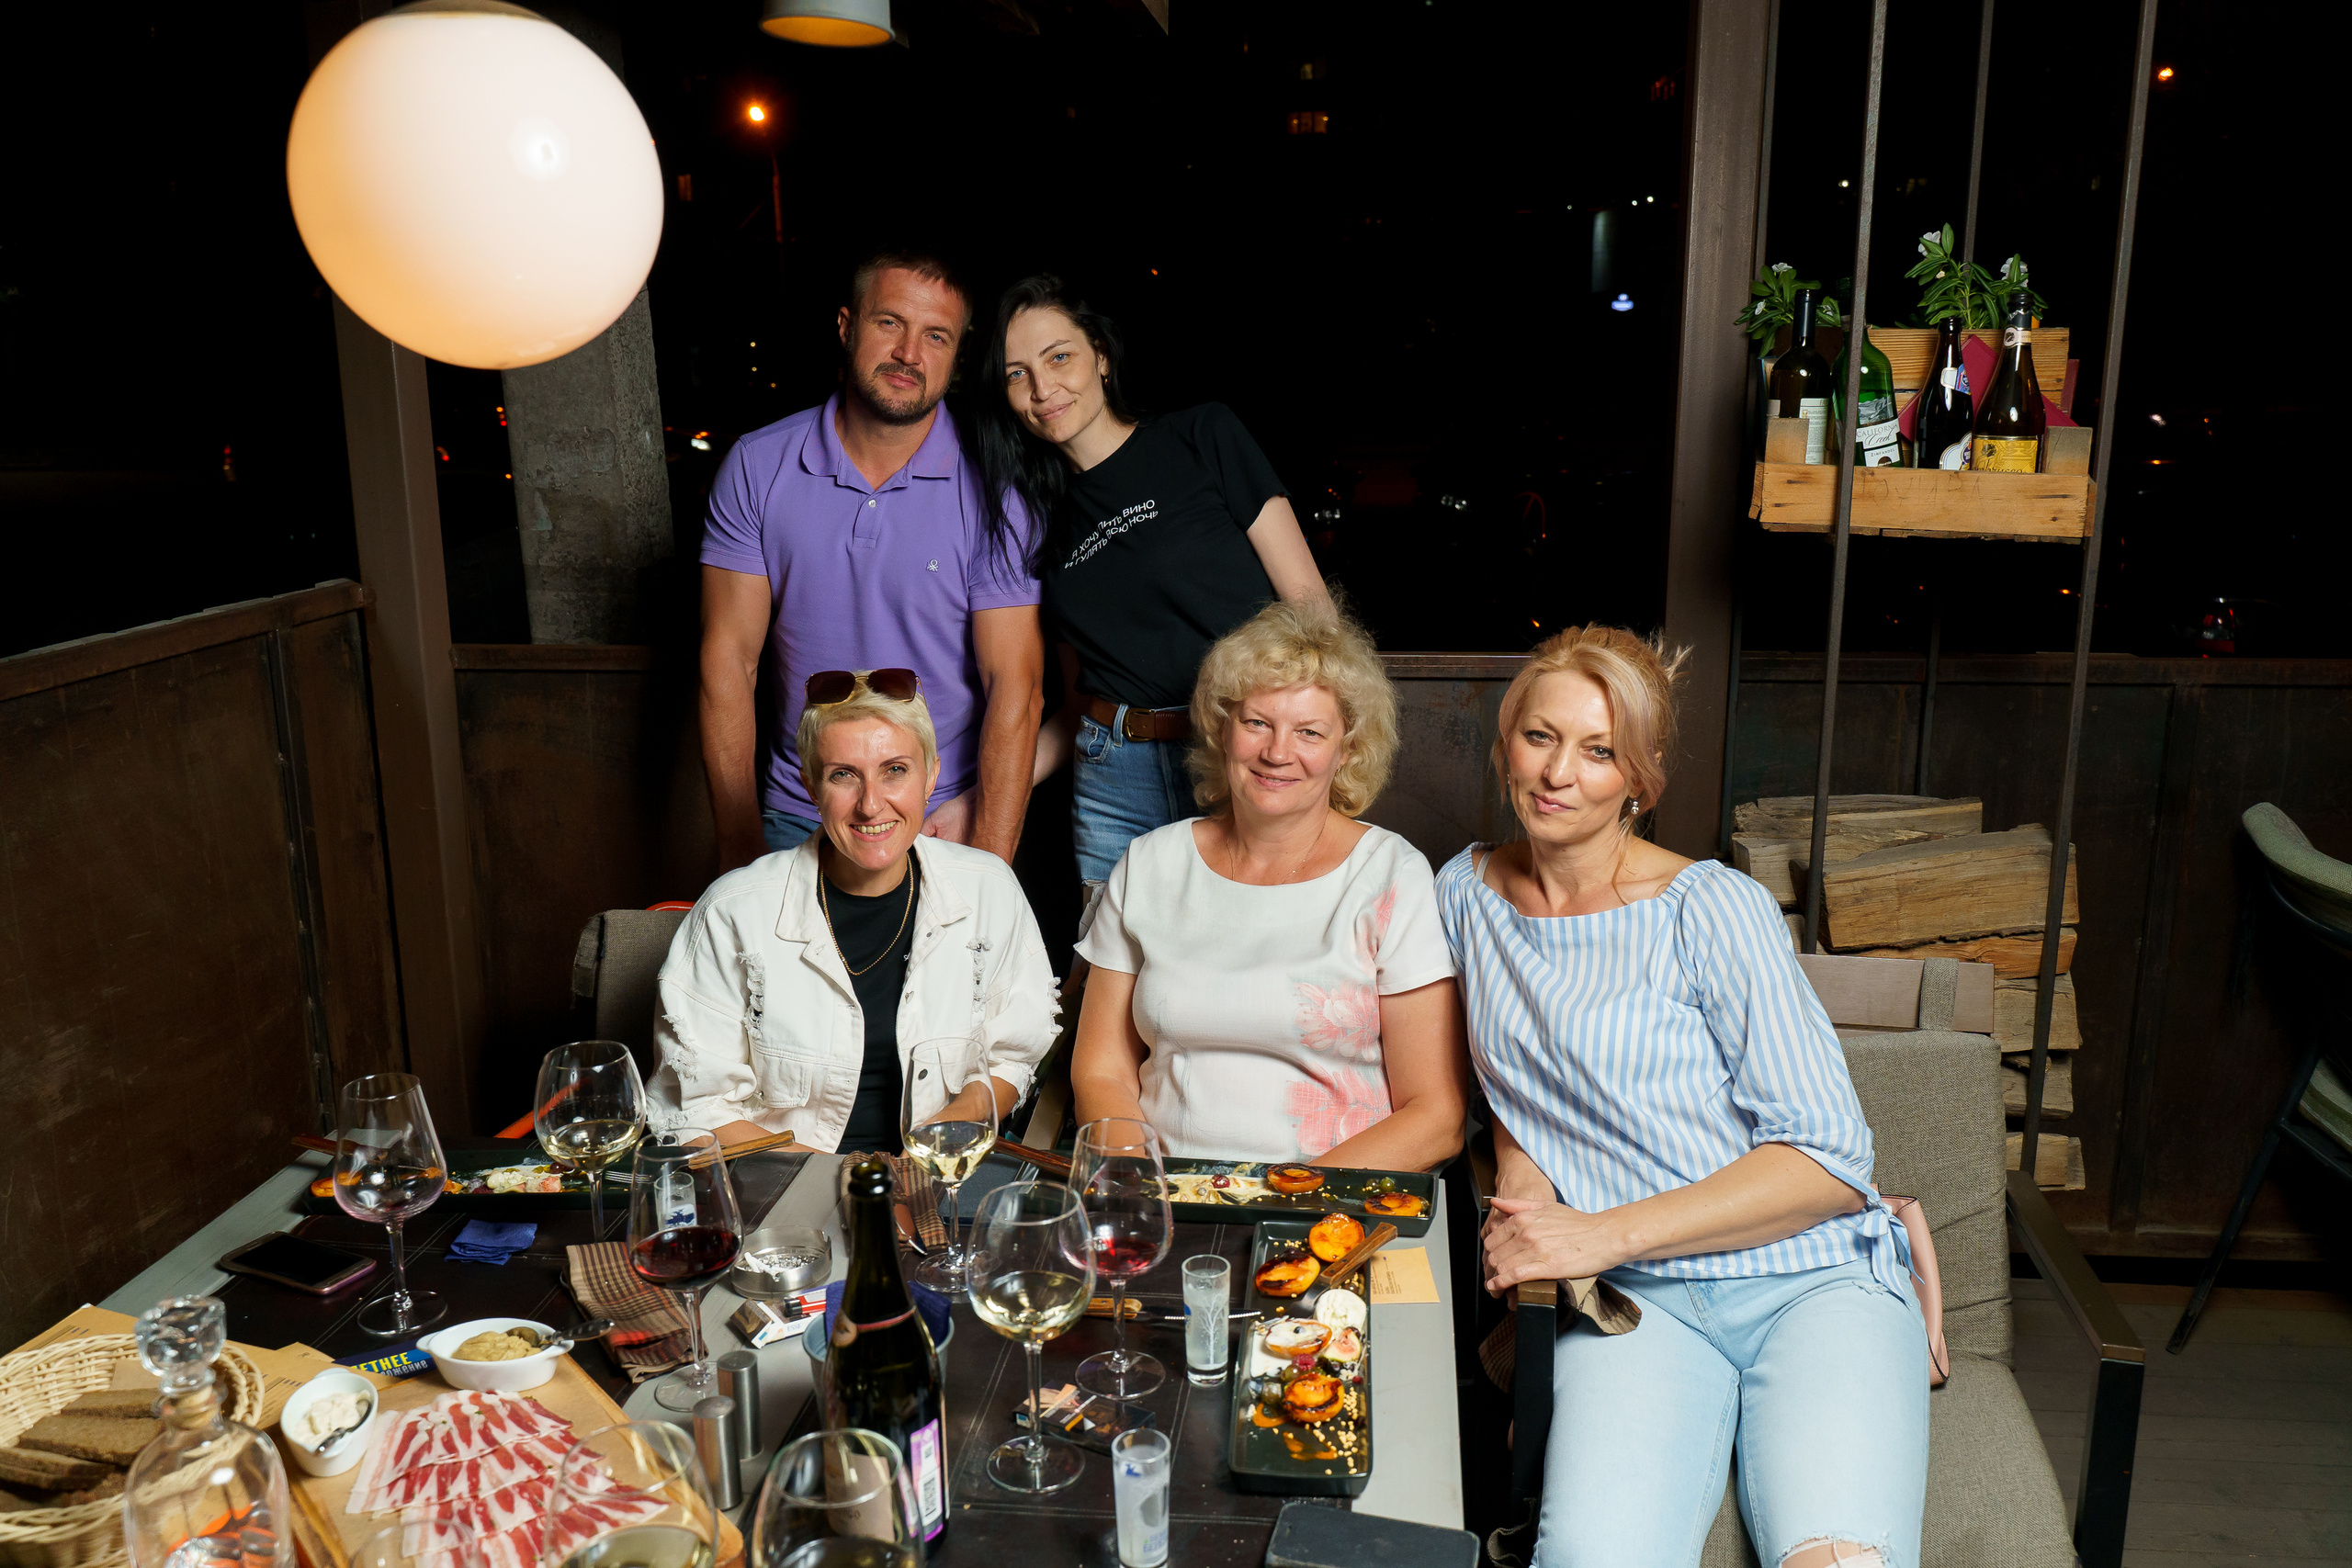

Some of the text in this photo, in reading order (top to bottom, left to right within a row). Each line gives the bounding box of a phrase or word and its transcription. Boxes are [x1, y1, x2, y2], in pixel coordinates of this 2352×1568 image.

[1871, 448, 1895, 457] ZINFANDEL
[1071, 499, 1155, 560] Я ХОЧУ ПИТЬ ВИНО
[1075, 538, 1108, 565] ГУЛЯТЬ
[1105, 523, 1128, 540] ВСЮ
[1128, 511, 1159, 527] НОЧЬ
